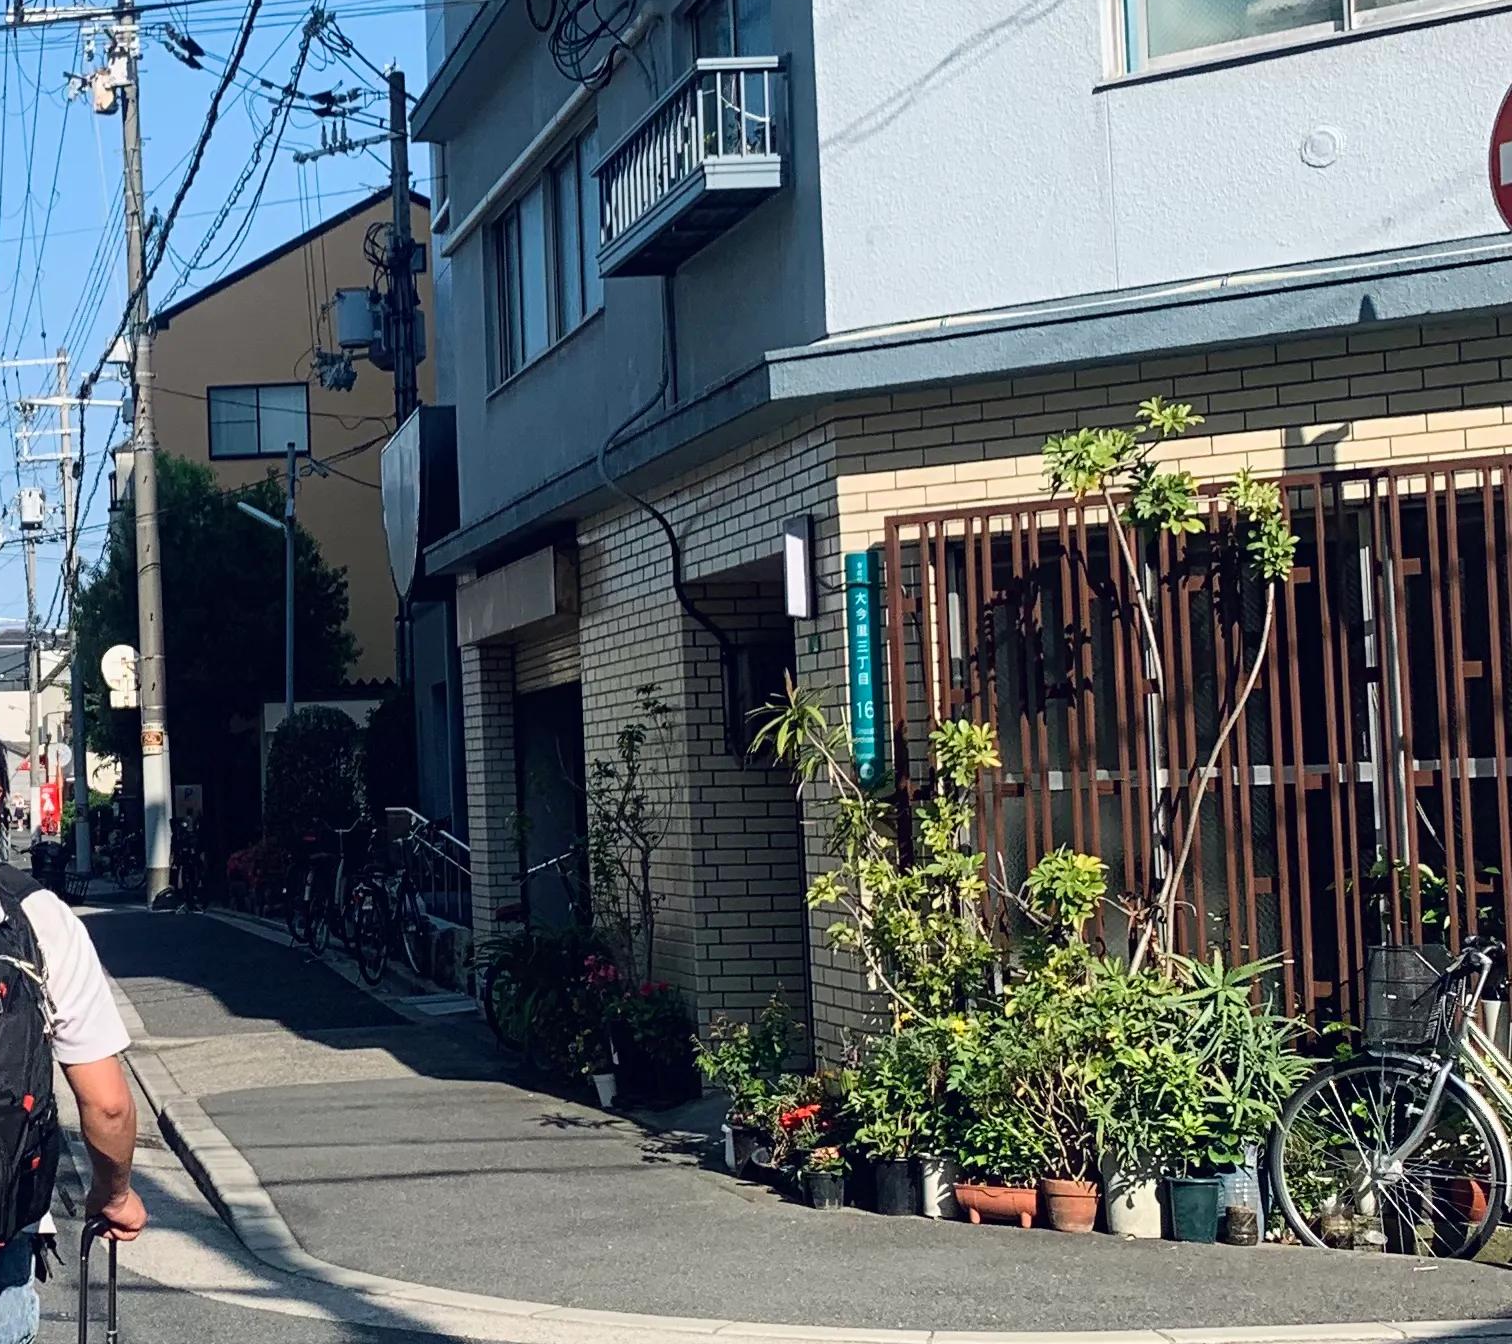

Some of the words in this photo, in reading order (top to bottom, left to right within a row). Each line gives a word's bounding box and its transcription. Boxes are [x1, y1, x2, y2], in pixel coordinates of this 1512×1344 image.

[855, 591, 869, 686] 大今里三丁目
[856, 700, 875, 719] 16
